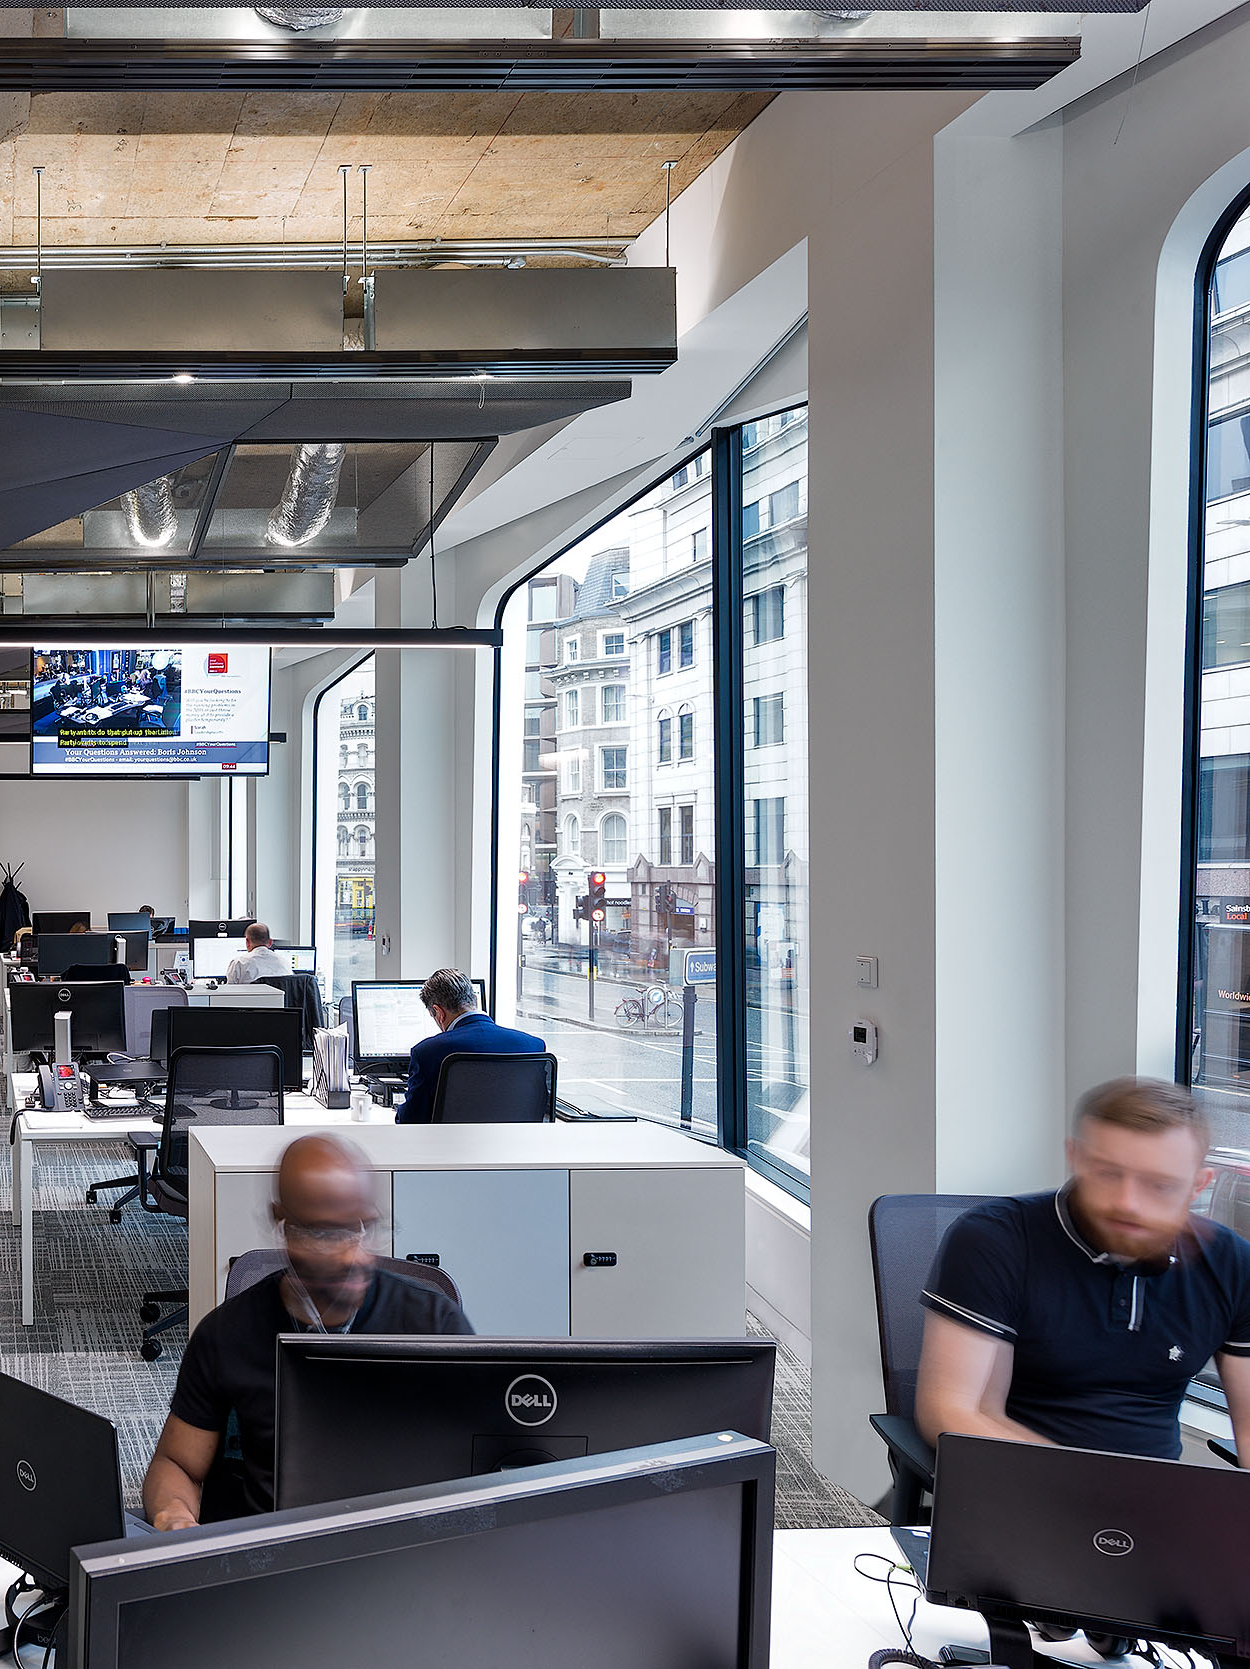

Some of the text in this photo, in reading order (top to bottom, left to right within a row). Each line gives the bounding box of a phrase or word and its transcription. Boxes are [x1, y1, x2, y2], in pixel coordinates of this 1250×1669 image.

[65, 748, 207, 757] Your Questions Answered: Boris Johnson
[1226, 912, 1248, 920] Local
[1218, 989, 1250, 1002] Worldwi
[511, 1393, 552, 1408] DELL
[19, 1468, 35, 1483] DELL
[1098, 1536, 1130, 1549] DELL
